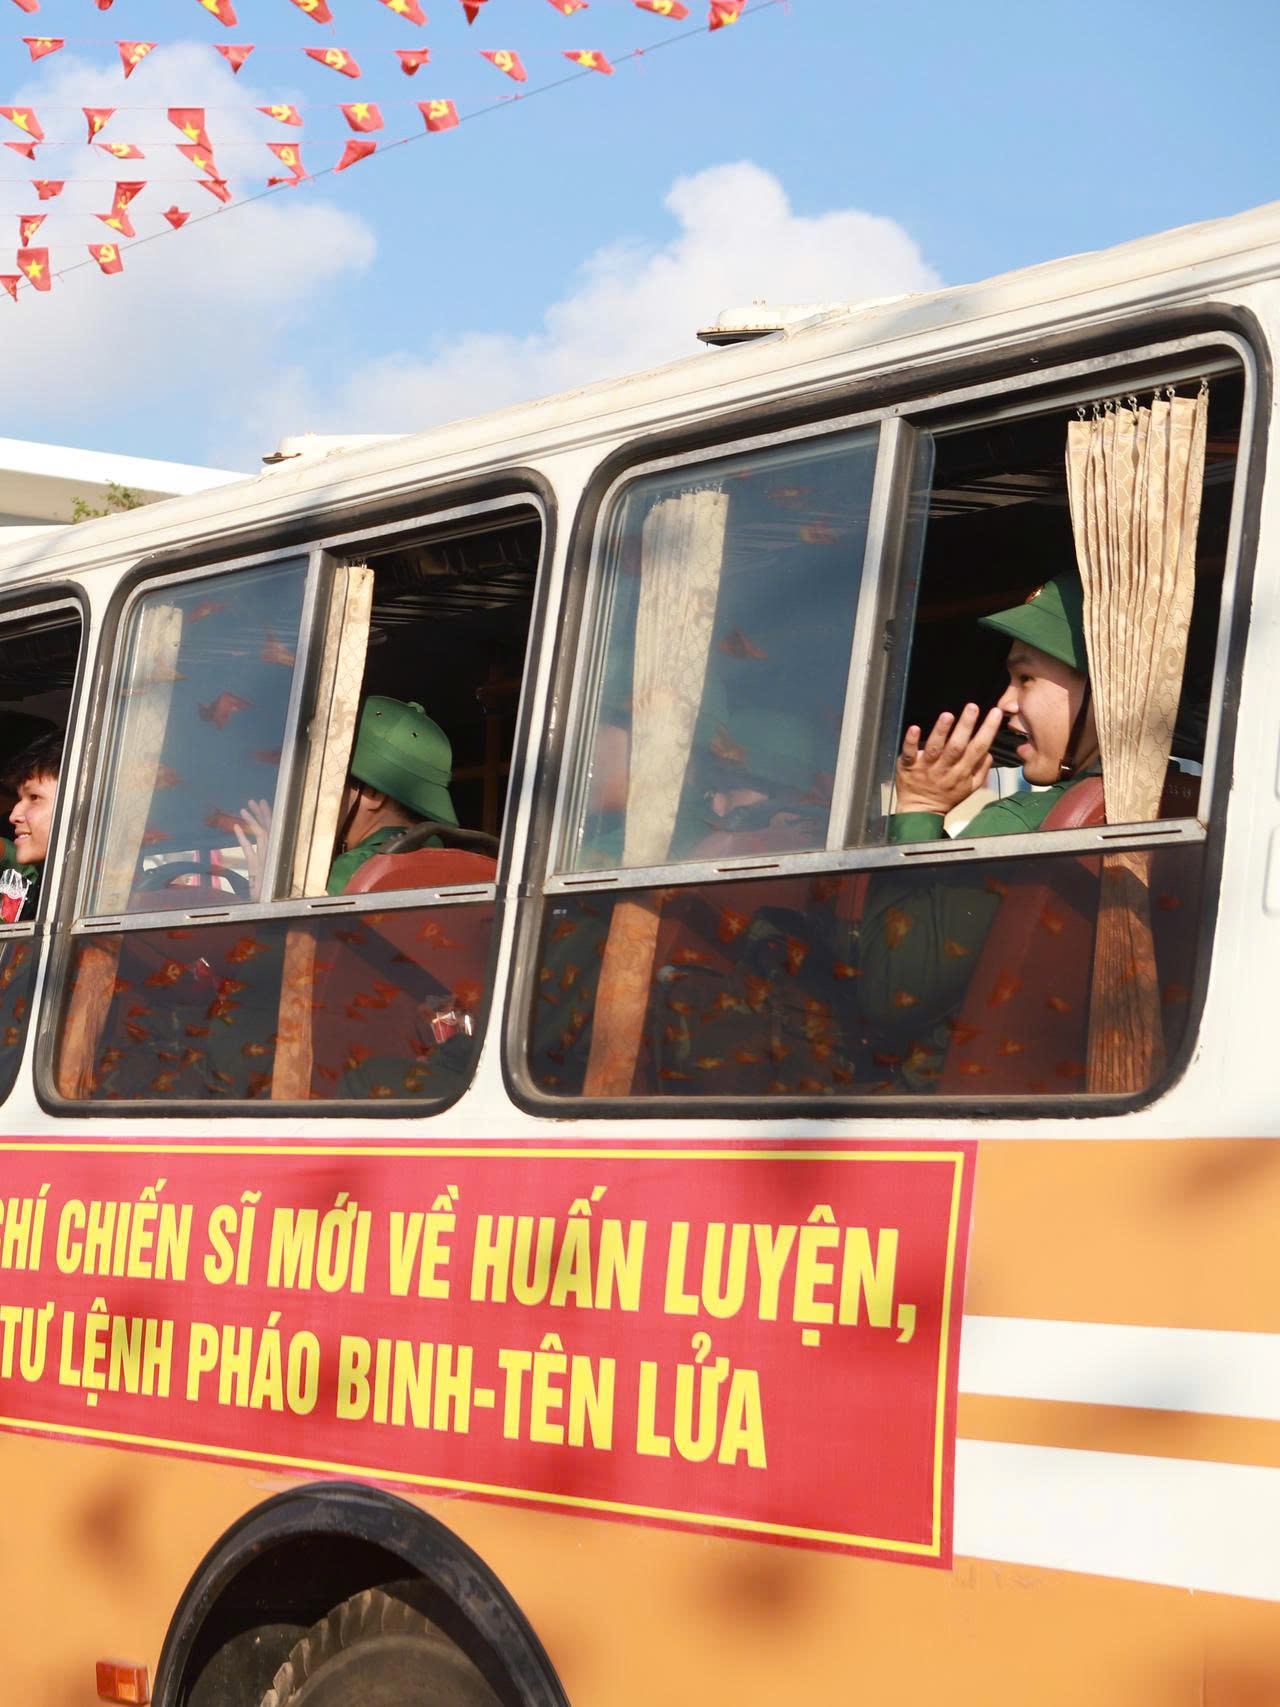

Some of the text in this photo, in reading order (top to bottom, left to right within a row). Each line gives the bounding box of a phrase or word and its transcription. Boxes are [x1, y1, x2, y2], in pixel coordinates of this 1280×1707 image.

[56, 1178, 193, 1281] CHIẾN
[204, 1190, 263, 1286] SĨ
[267, 1192, 373, 1294] MỚI
[389, 1184, 460, 1299] VỀ
[470, 1185, 647, 1312] HUẤN
[663, 1204, 918, 1347] LUYỆN,
[0, 1300, 55, 1383] TƯ
[58, 1297, 175, 1407] LỆNH
[186, 1311, 321, 1415] PHÁO
[336, 1332, 617, 1450] BINH-TÊN
[636, 1331, 768, 1469] LỬA
